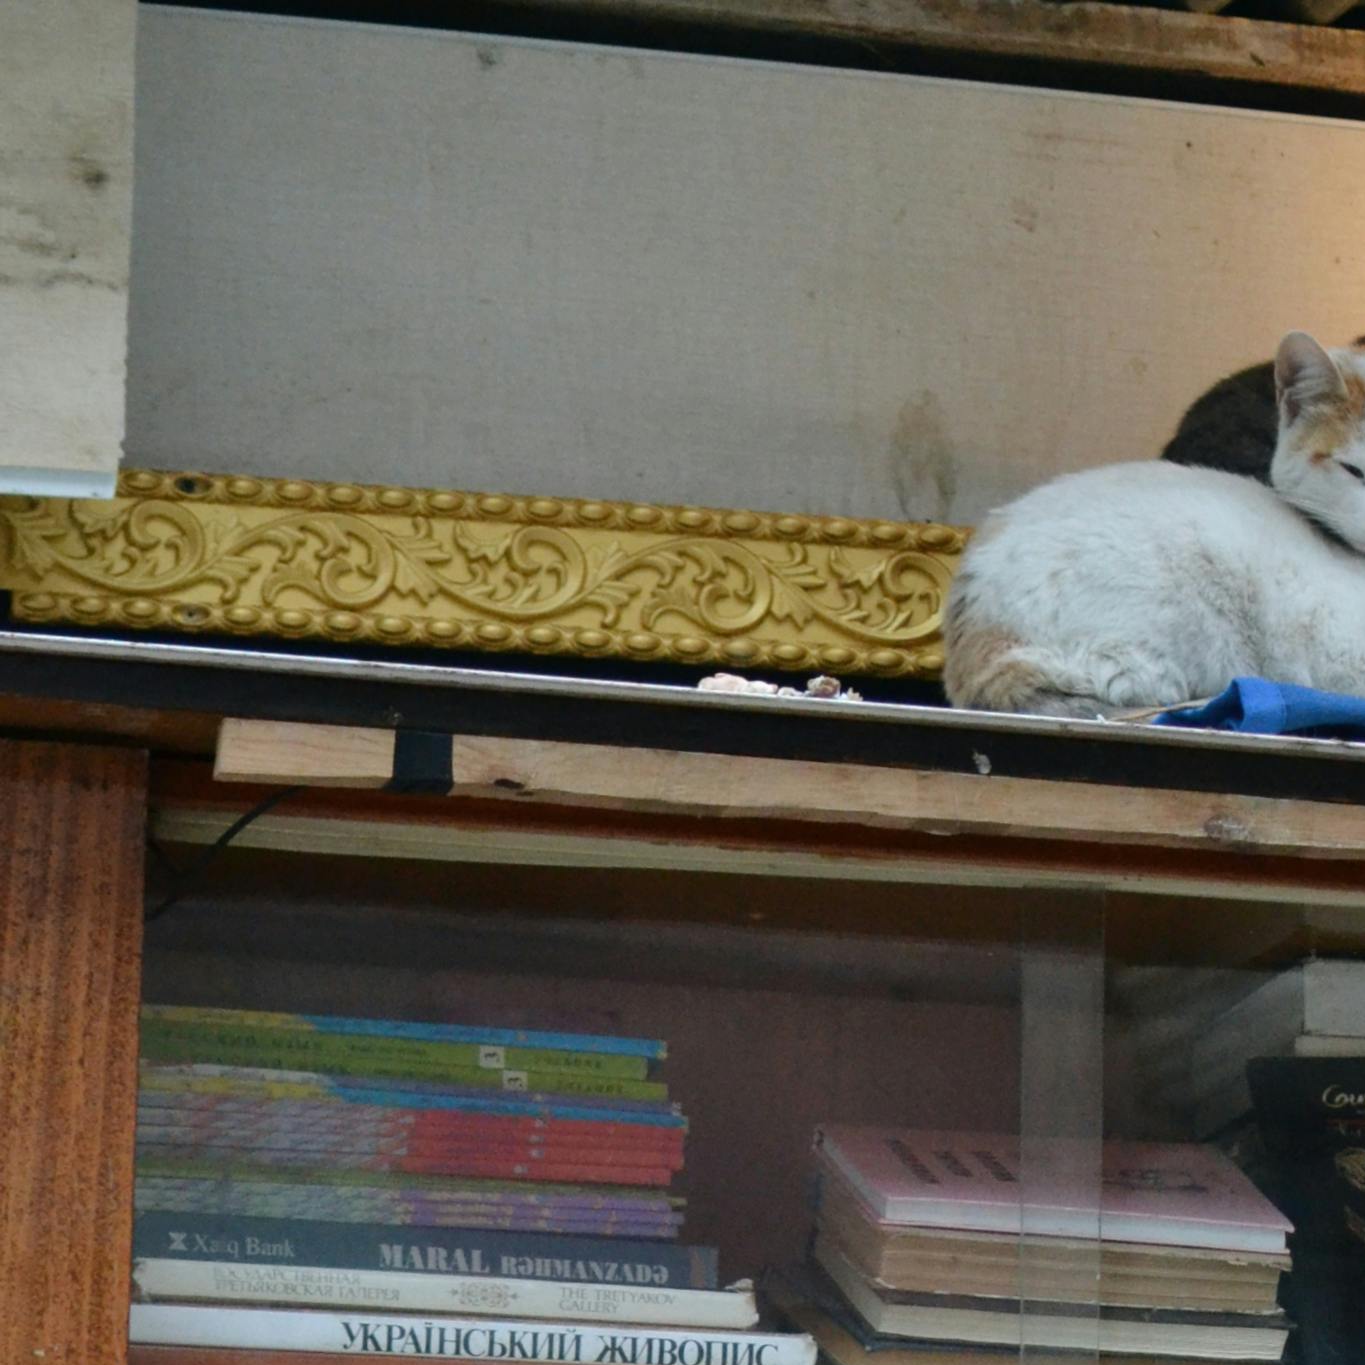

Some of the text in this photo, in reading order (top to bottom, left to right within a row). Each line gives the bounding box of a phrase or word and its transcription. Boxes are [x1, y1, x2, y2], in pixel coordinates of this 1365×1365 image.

[246, 1236, 296, 1258] Bank
[378, 1243, 670, 1285] MARAL RƏHMANZADƏ
[561, 1288, 588, 1300] THE
[559, 1300, 619, 1314] GALLERY
[341, 1320, 583, 1363] УКРАЇНСЬКИЙ
